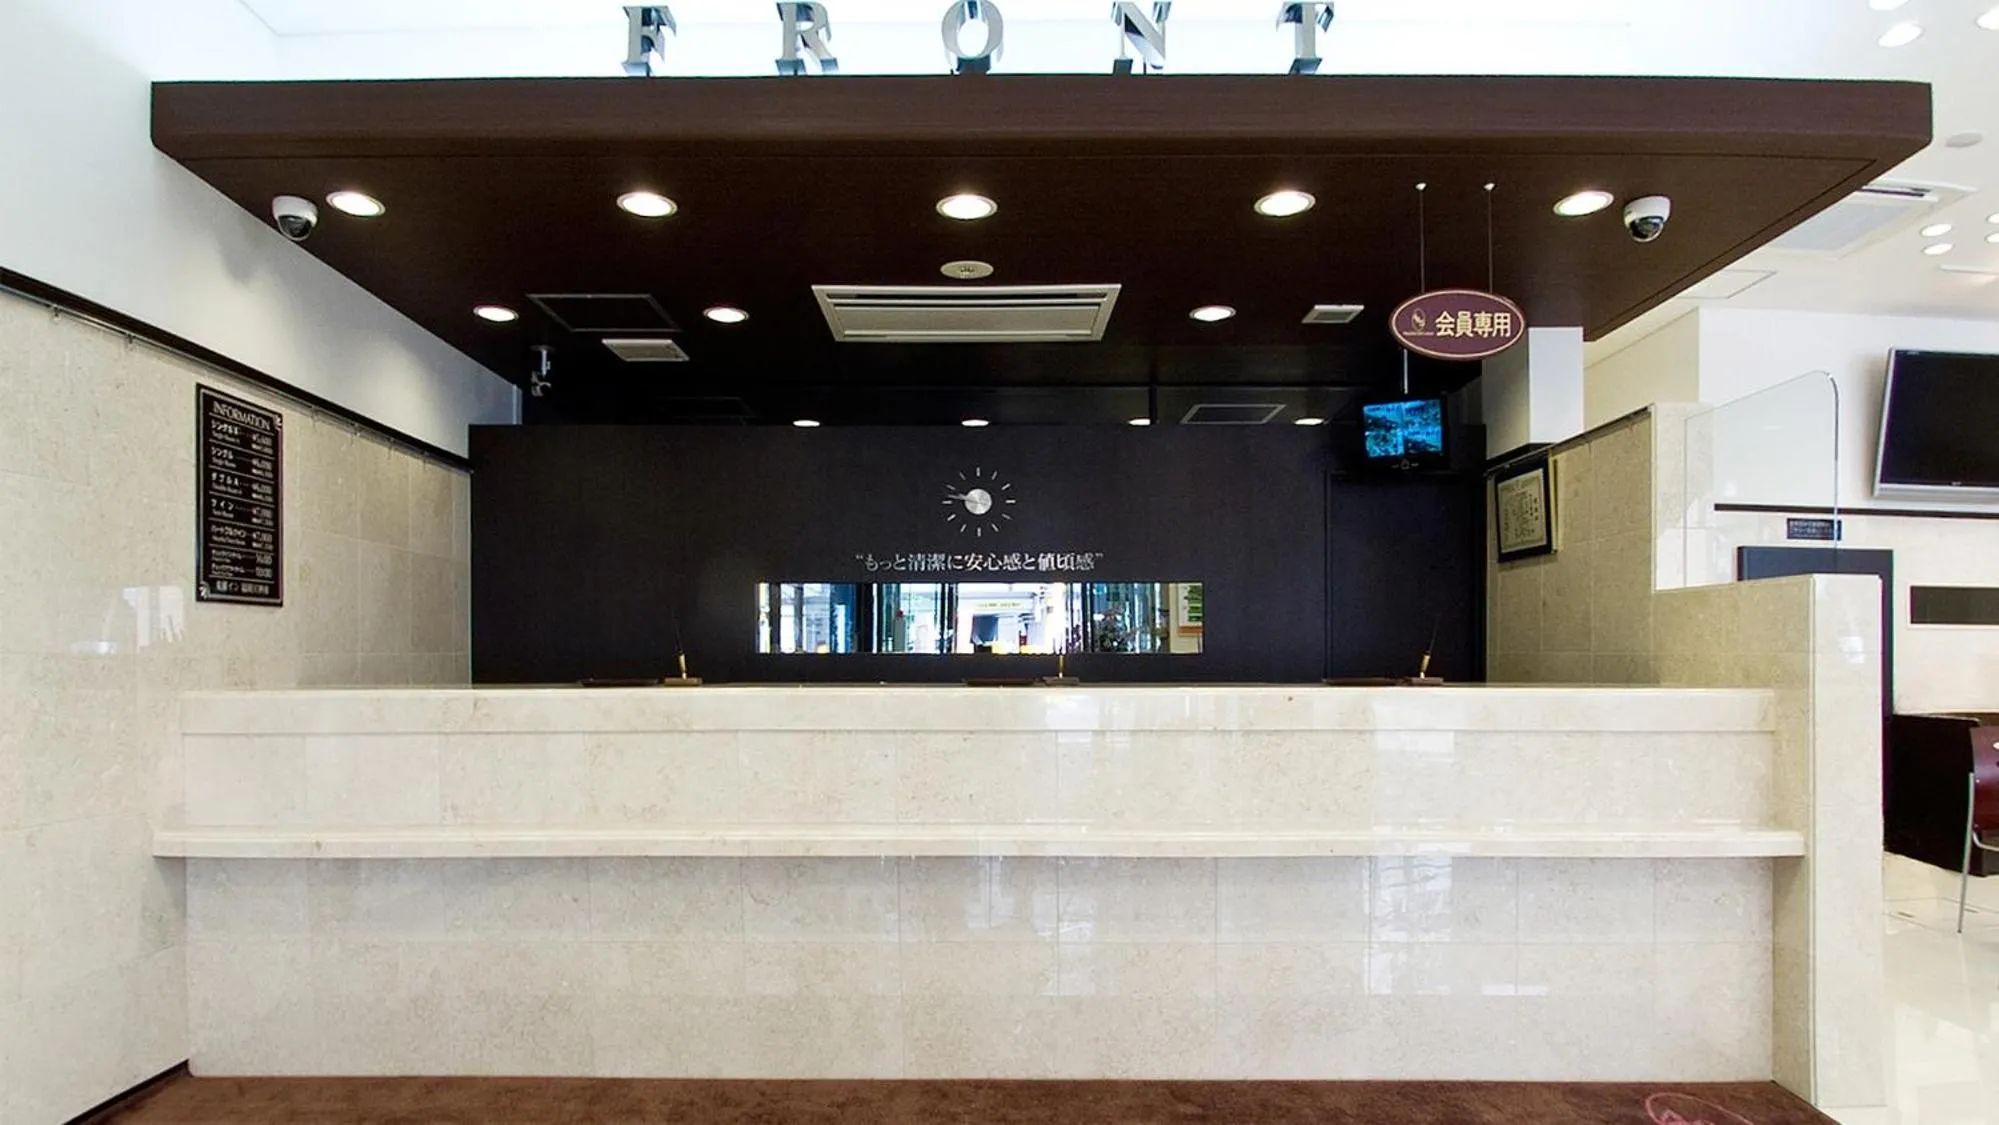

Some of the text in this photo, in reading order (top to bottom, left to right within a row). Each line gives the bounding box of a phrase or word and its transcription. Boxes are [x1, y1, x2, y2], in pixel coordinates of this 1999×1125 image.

[620, 0, 1336, 76] FRONT
[1435, 310, 1511, 338] 会員専用
[213, 401, 271, 430] INFORMATION
